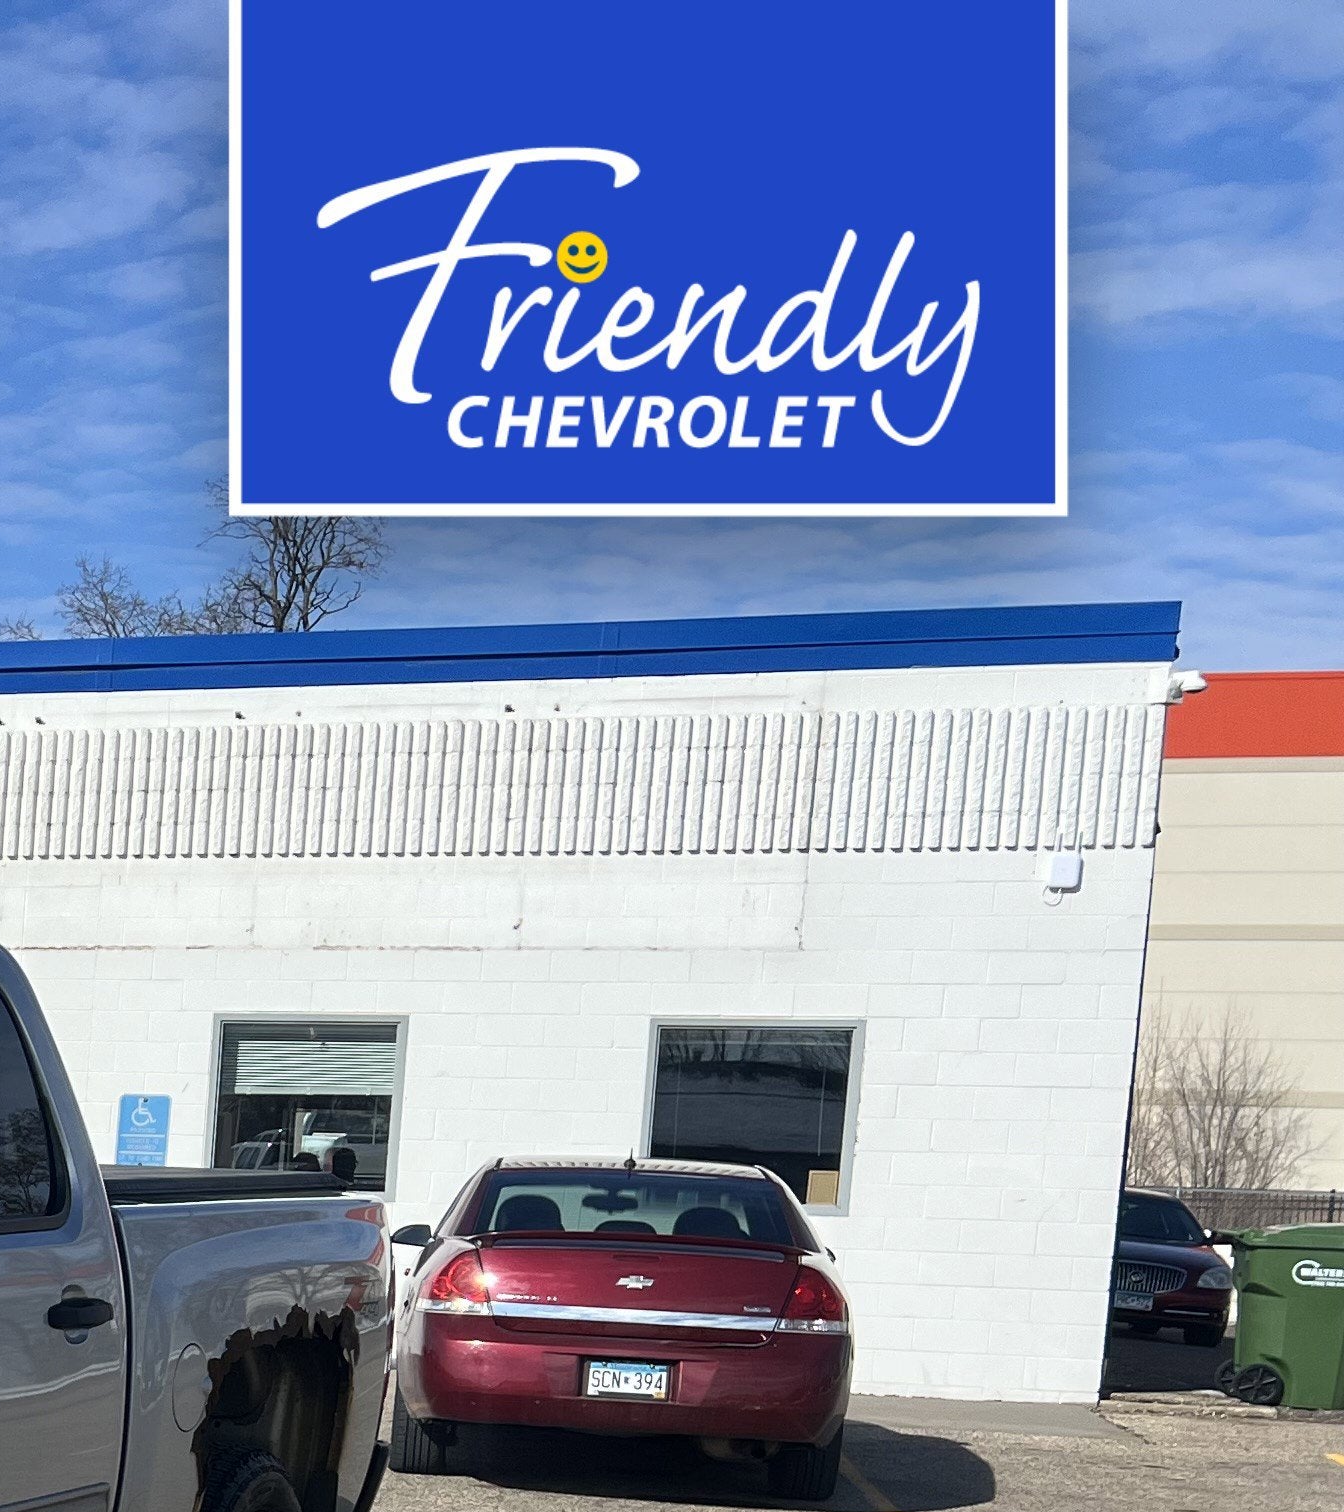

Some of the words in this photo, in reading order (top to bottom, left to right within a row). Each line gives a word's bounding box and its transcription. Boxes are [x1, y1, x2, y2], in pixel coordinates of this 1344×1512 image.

[1300, 1267, 1344, 1278] WALTER
[591, 1370, 622, 1389] SCN
[633, 1372, 663, 1391] 394
